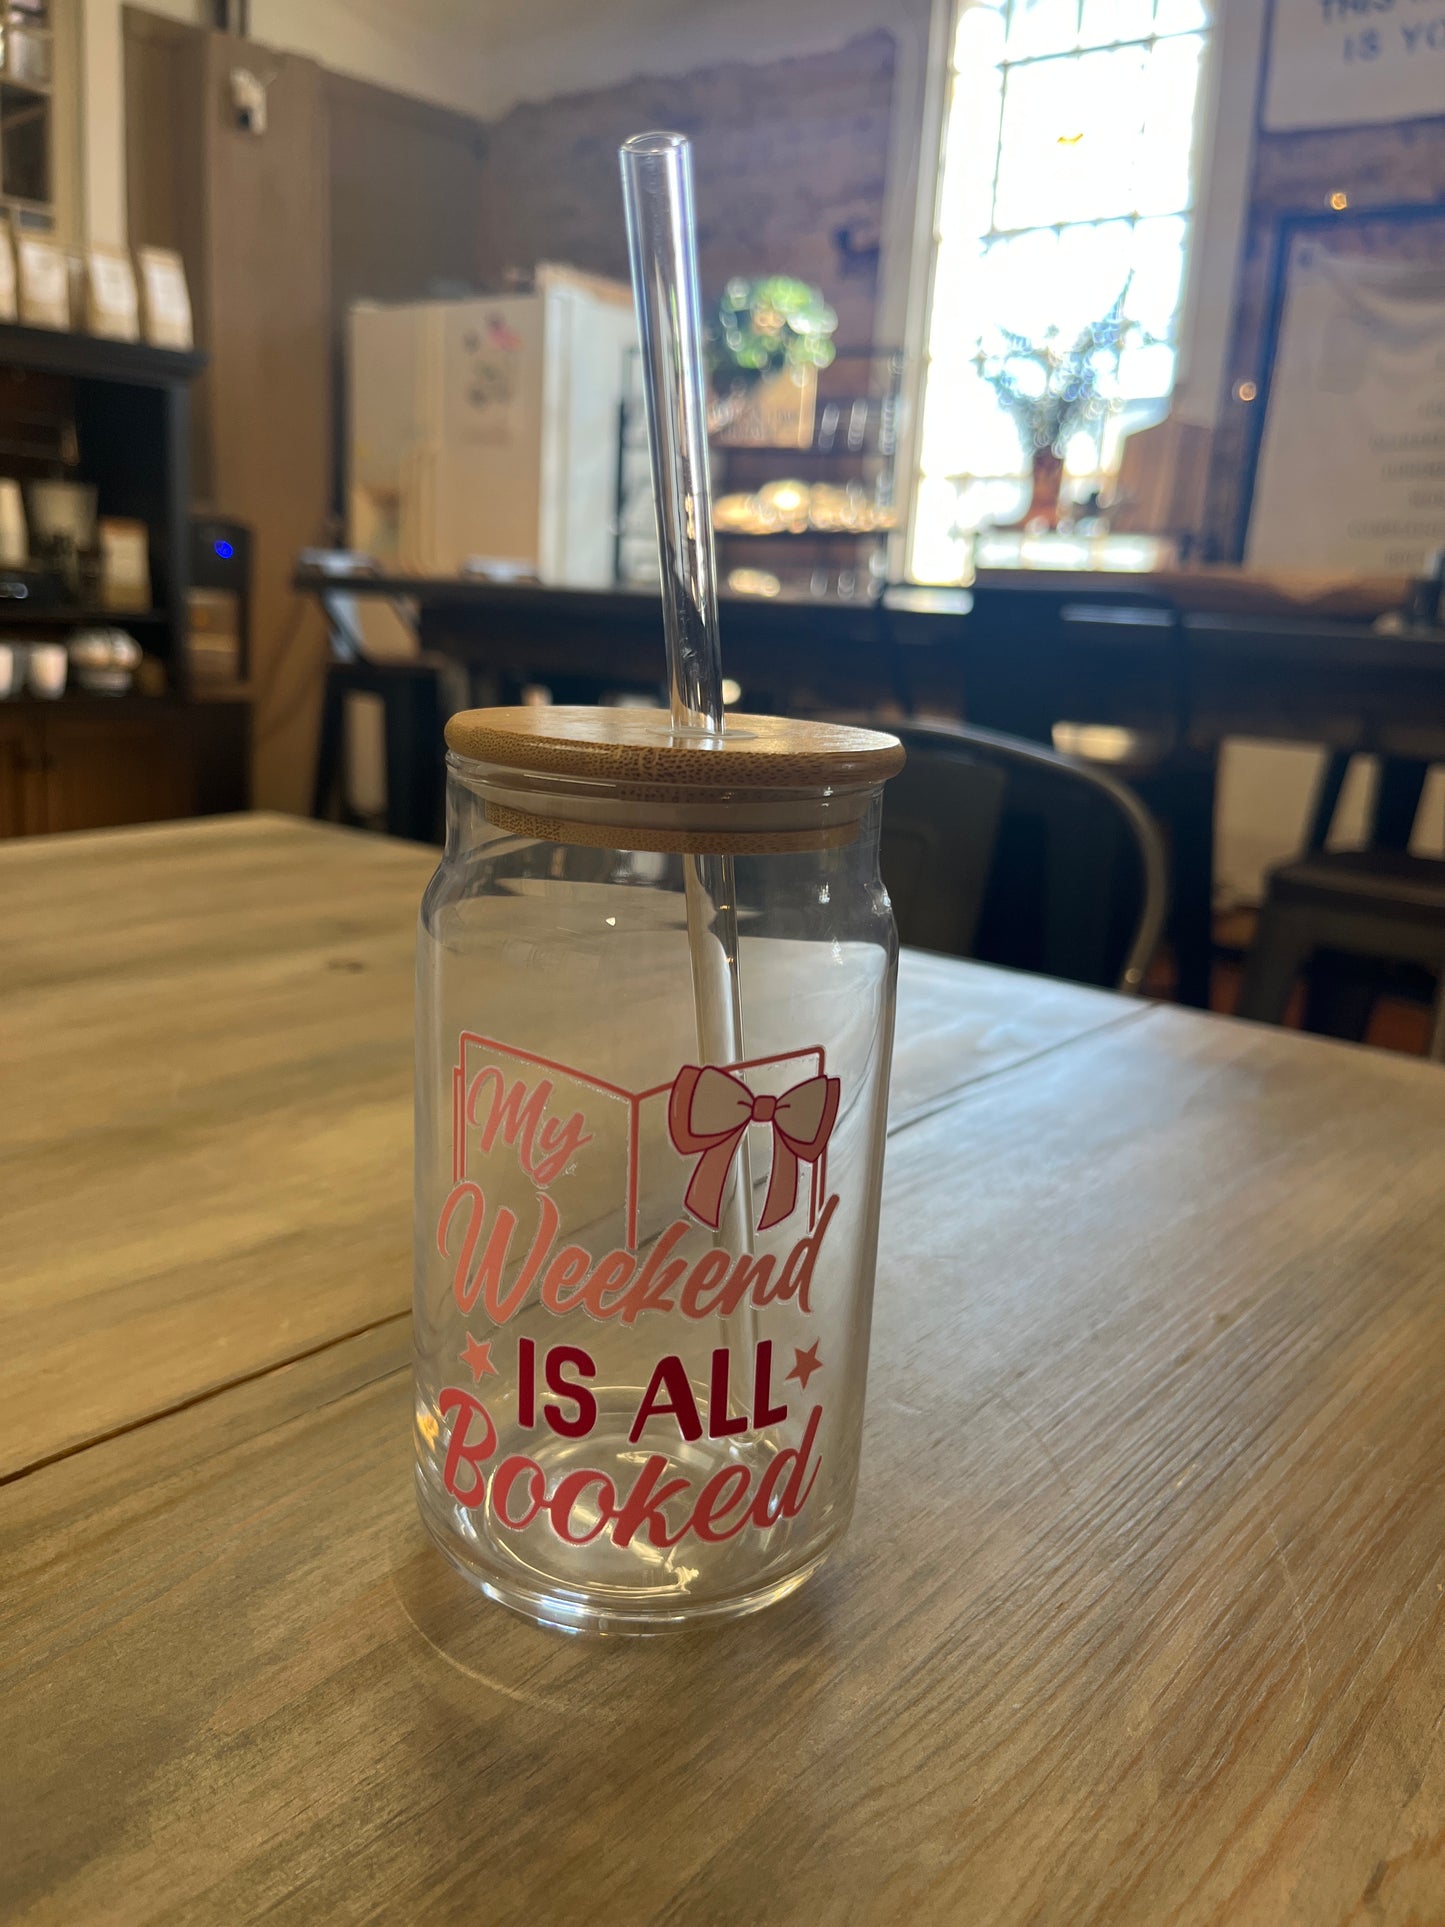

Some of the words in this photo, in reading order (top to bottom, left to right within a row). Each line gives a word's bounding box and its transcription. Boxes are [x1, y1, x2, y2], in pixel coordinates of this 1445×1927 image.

[466, 1066, 593, 1187] My
[437, 1182, 841, 1325] Weekend
[518, 1337, 598, 1440] IS
[628, 1339, 789, 1444] ALL
[438, 1387, 824, 1548] Booked
